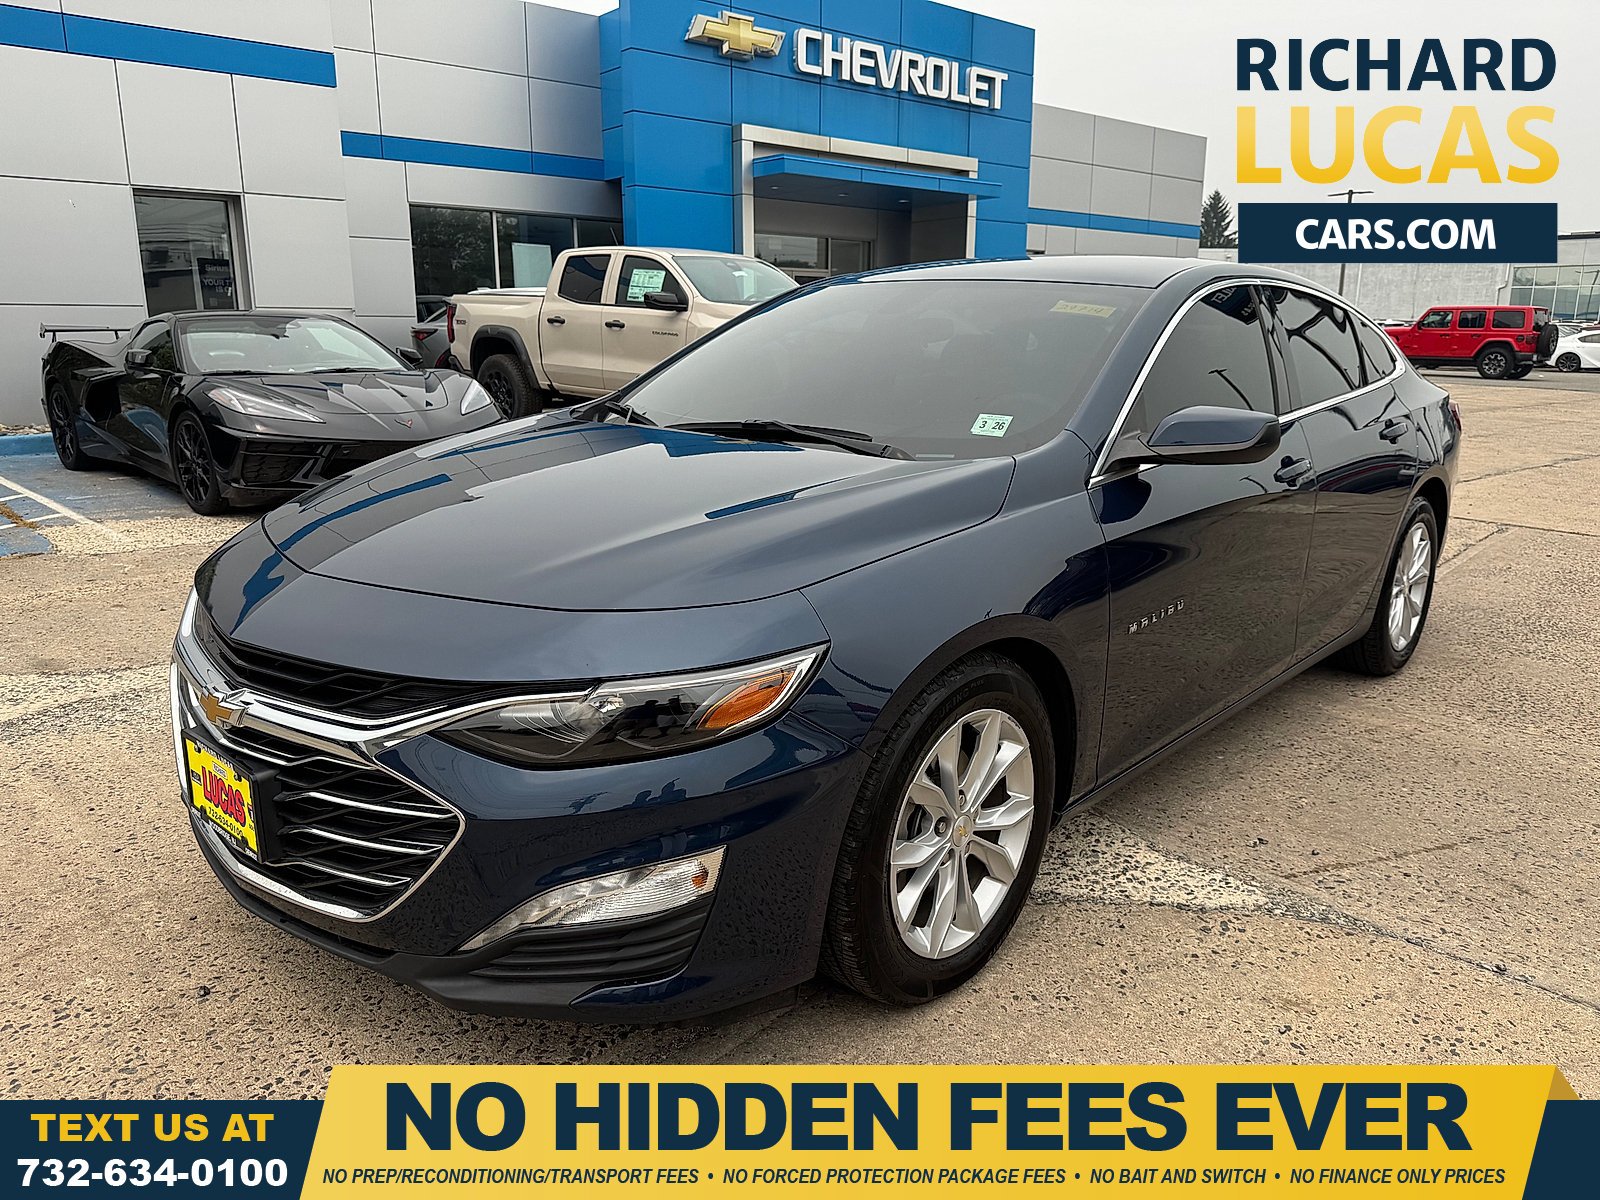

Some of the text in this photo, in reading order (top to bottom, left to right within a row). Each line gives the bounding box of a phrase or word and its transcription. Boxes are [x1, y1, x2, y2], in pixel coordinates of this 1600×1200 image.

[793, 28, 1008, 109] CHEVROLET
[979, 420, 988, 429] 3
[991, 421, 1006, 431] 26
[1128, 599, 1185, 635] MALIBU
[201, 765, 247, 828] LUCAS
